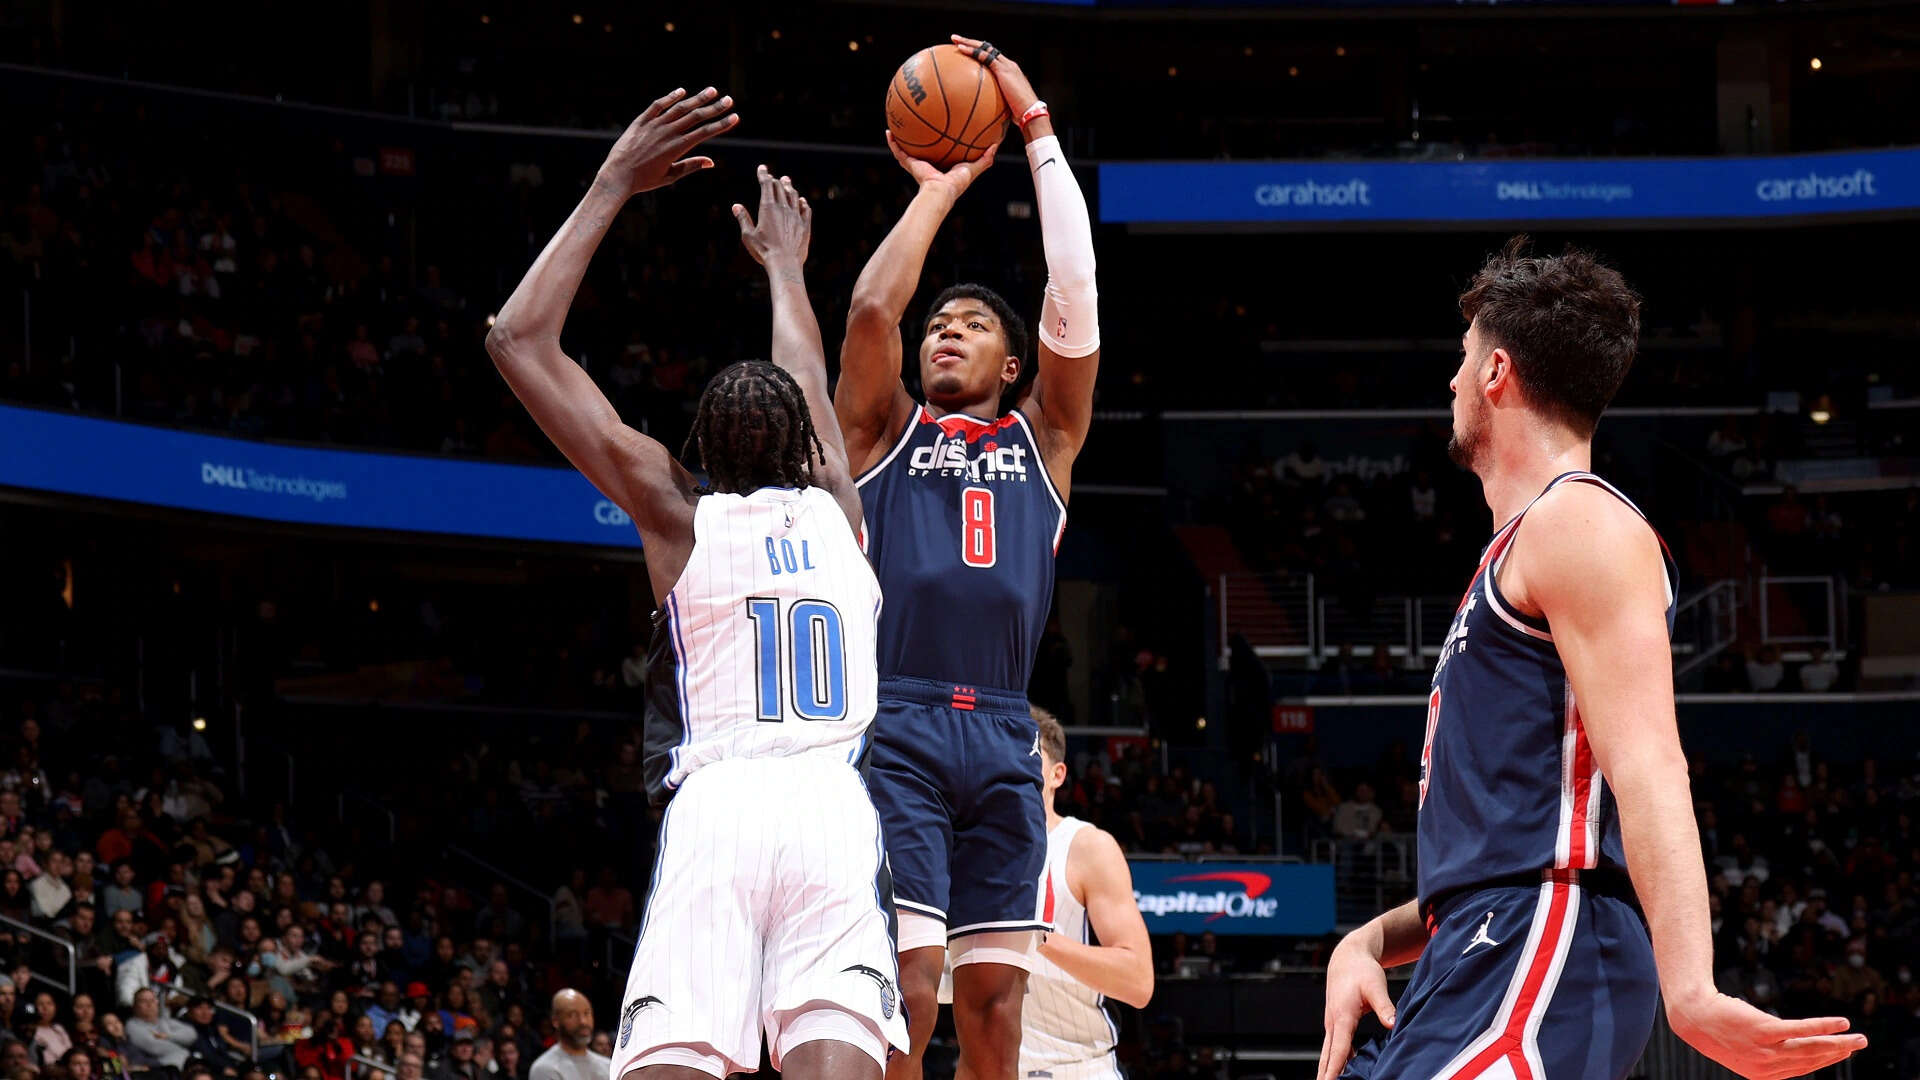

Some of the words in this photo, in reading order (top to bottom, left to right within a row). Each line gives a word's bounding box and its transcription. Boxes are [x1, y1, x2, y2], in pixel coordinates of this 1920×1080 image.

[1255, 178, 1371, 206] carahsoft
[1498, 181, 1541, 200] DELL
[1757, 168, 1877, 200] carahsoft
[202, 463, 248, 489] DELL
[247, 469, 346, 501] Technologies
[962, 487, 997, 568] 8
[765, 536, 816, 575] BOL
[746, 597, 848, 723] 10
